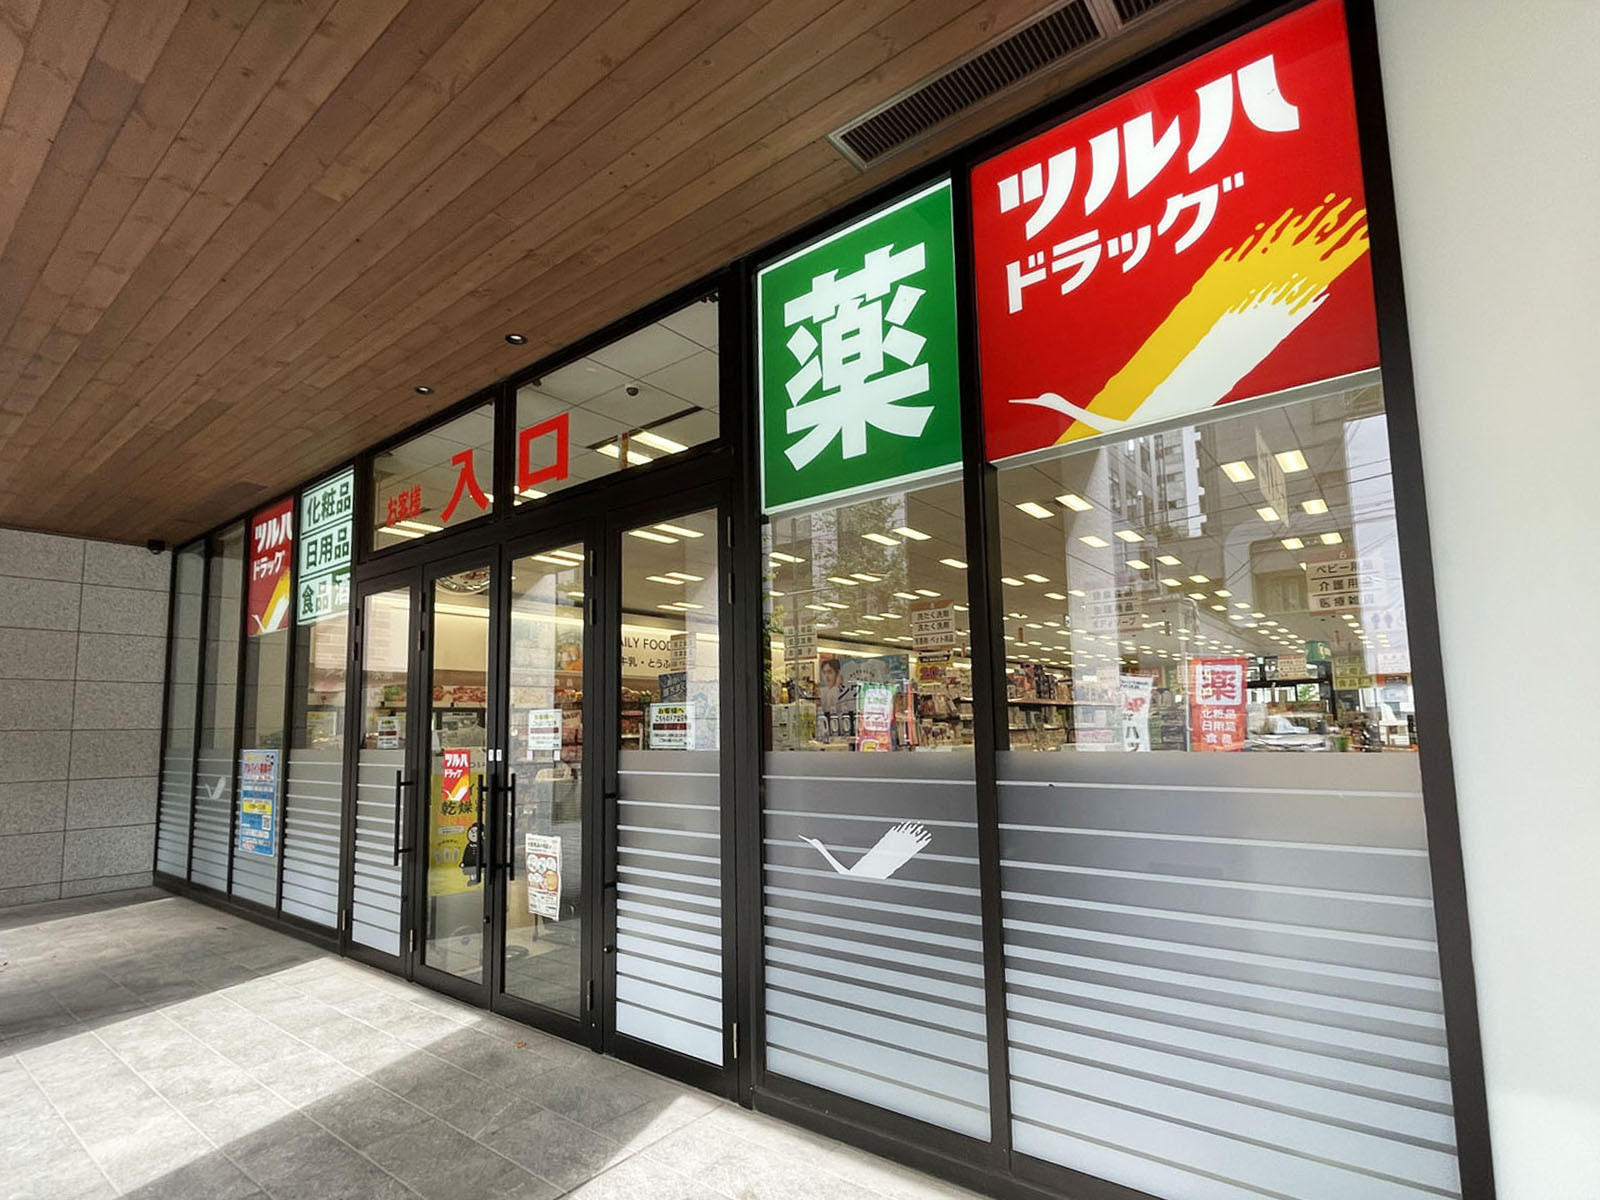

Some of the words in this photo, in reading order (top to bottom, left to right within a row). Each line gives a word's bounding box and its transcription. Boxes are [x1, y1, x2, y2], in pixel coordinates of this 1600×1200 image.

[997, 54, 1300, 241] ツルハ
[1005, 171, 1244, 315] ドラッグ
[784, 242, 935, 471] 薬
[307, 481, 351, 527] 化粧品
[255, 511, 292, 553] ツルハ
[306, 527, 349, 569] 日用品
[253, 550, 285, 581] ドラッグ
[1201, 670, 1237, 700] 薬
[1202, 709, 1236, 719] 化粧品
[444, 753, 469, 768] ツルハ
